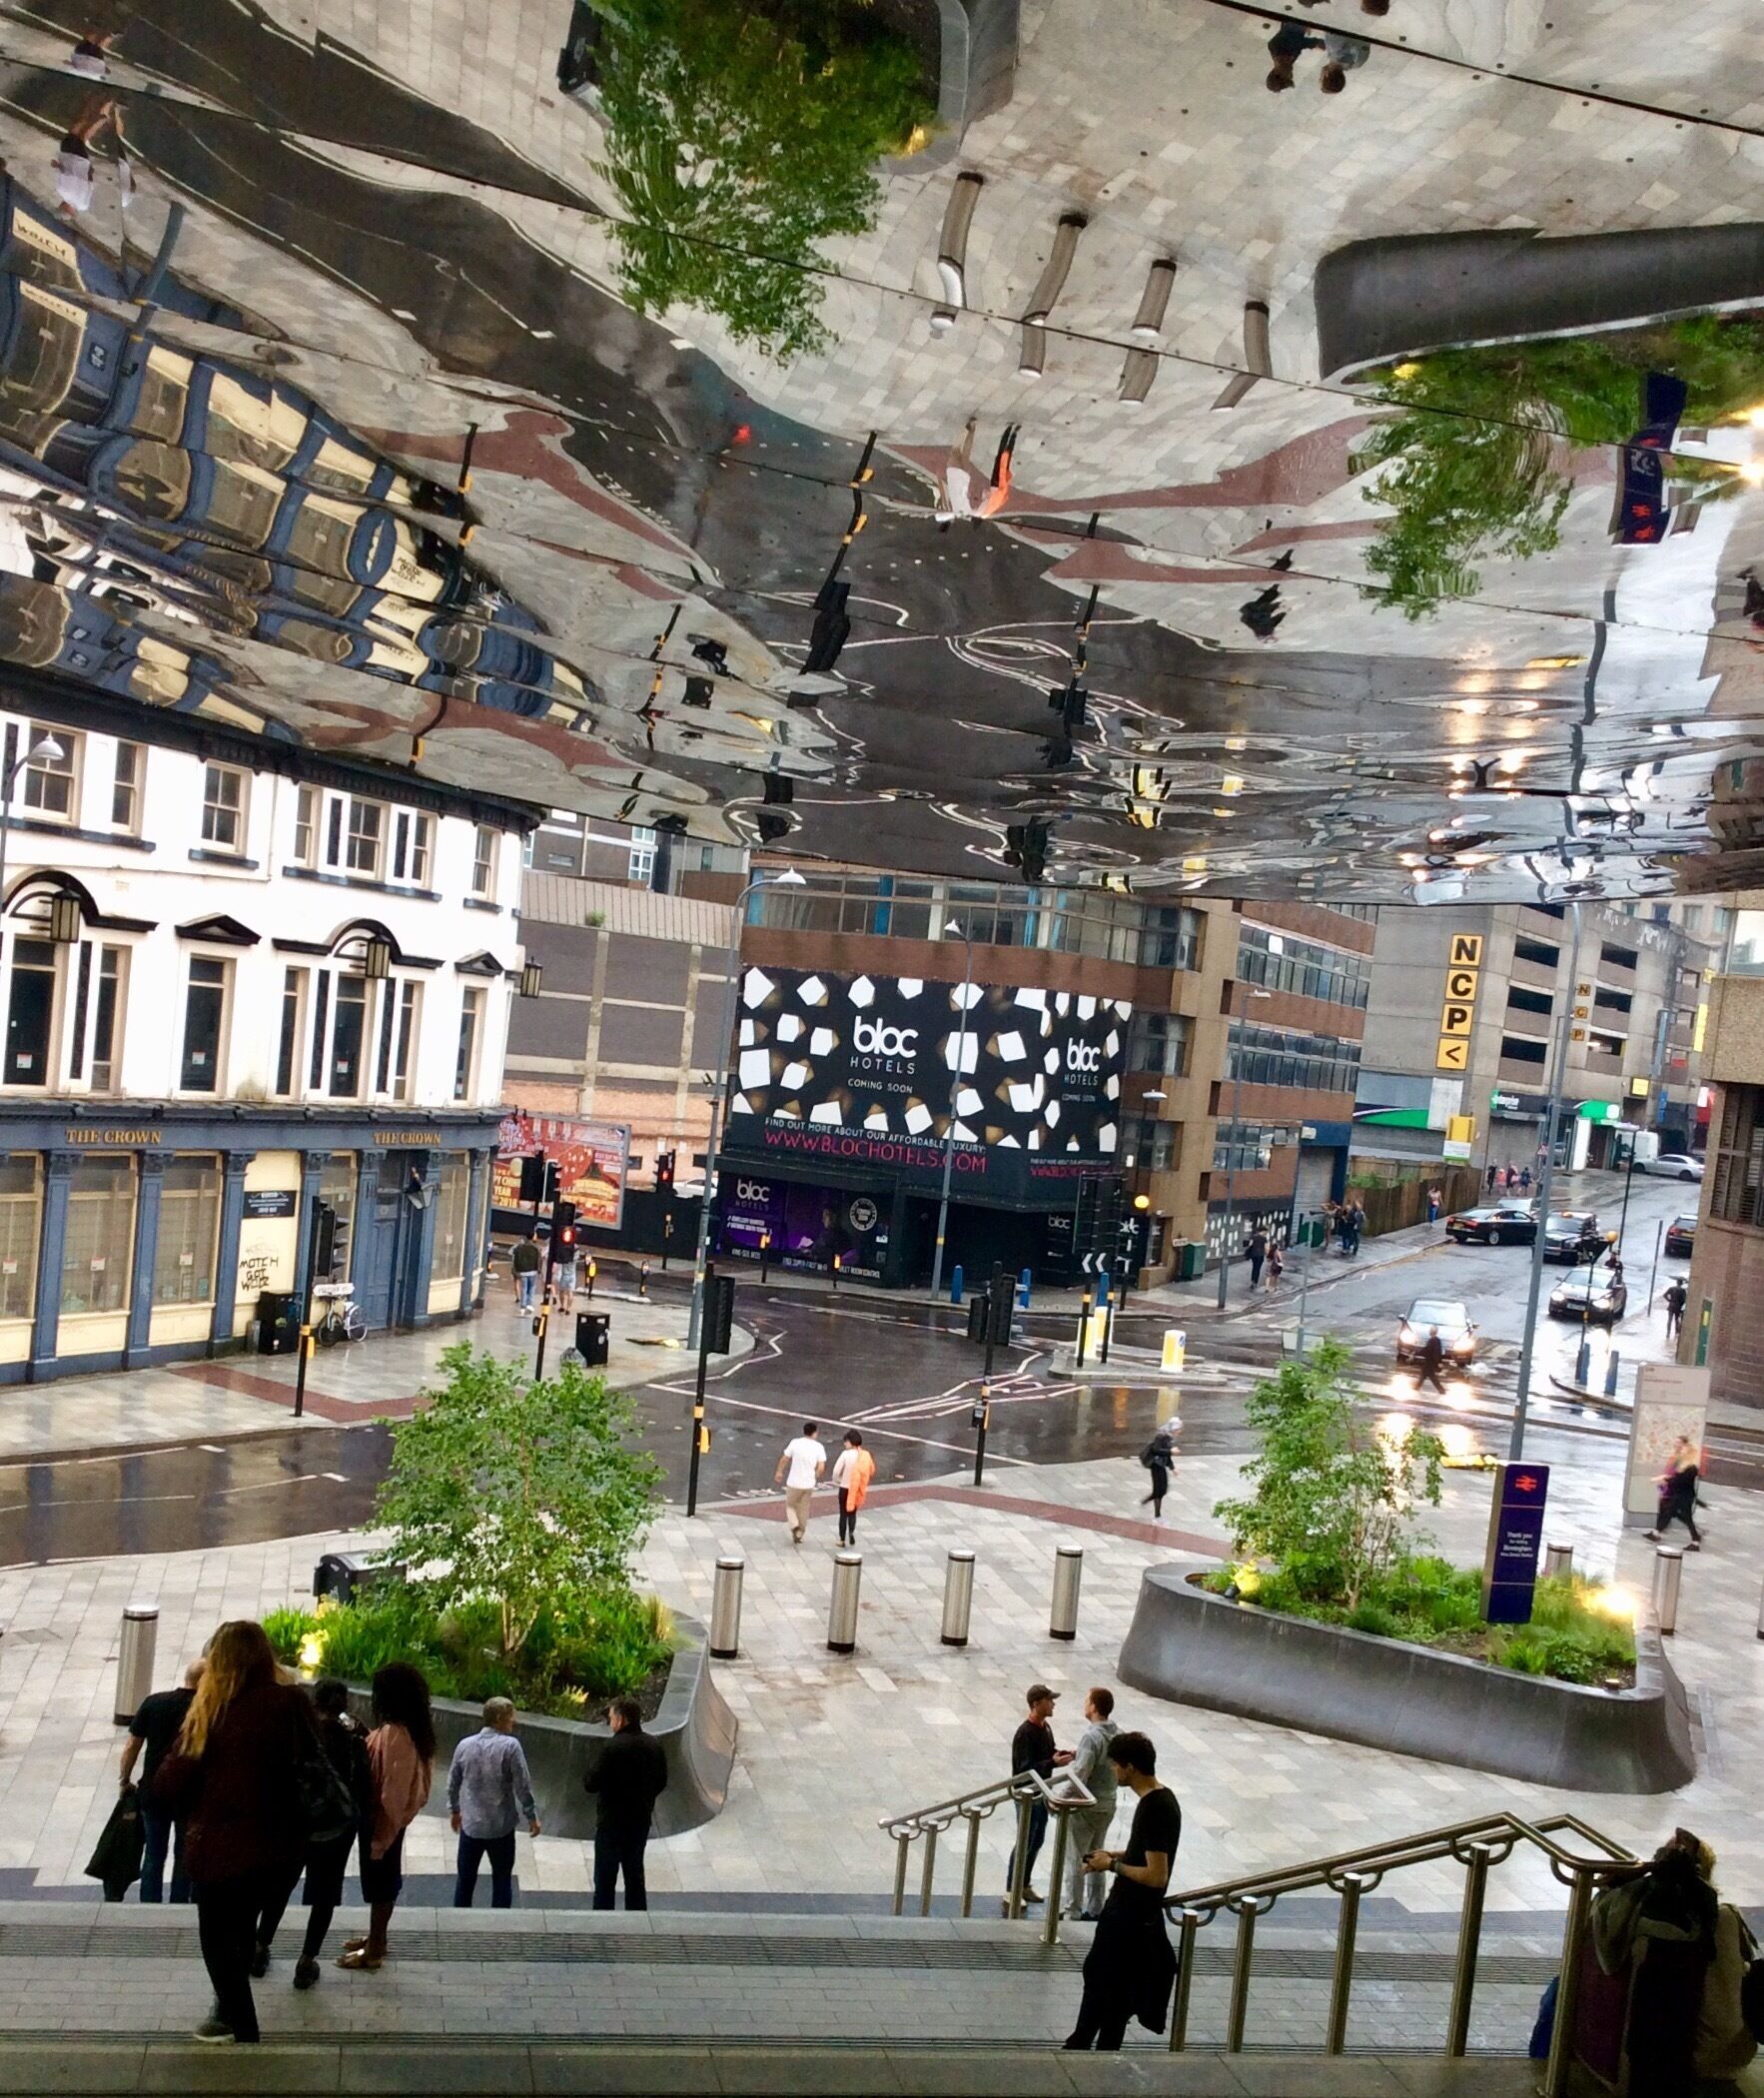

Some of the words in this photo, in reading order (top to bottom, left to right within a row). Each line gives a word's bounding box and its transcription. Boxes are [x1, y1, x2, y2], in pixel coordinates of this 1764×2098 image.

[853, 1015, 919, 1058] bloc
[1067, 1037, 1101, 1072] bloc
[850, 1056, 916, 1075] HOTELS
[847, 1078, 883, 1091] COMING
[887, 1082, 913, 1094] SOON
[1064, 1073, 1099, 1087] HOTELS
[66, 1128, 100, 1144] THE
[104, 1128, 161, 1144] CROWN
[374, 1131, 397, 1145] THE
[401, 1131, 441, 1145] CROWN
[764, 1117, 784, 1128] FIND
[787, 1120, 805, 1131] OUT
[808, 1123, 832, 1135] MORE
[834, 1126, 863, 1138] ABOUT
[866, 1129, 886, 1141] OUR
[888, 1133, 944, 1150] AFFORDABLE
[949, 1141, 986, 1155] UXURY:
[736, 1178, 770, 1202] bloc
[1048, 1215, 1071, 1230] bloc
[246, 1268, 267, 1282] GOT
